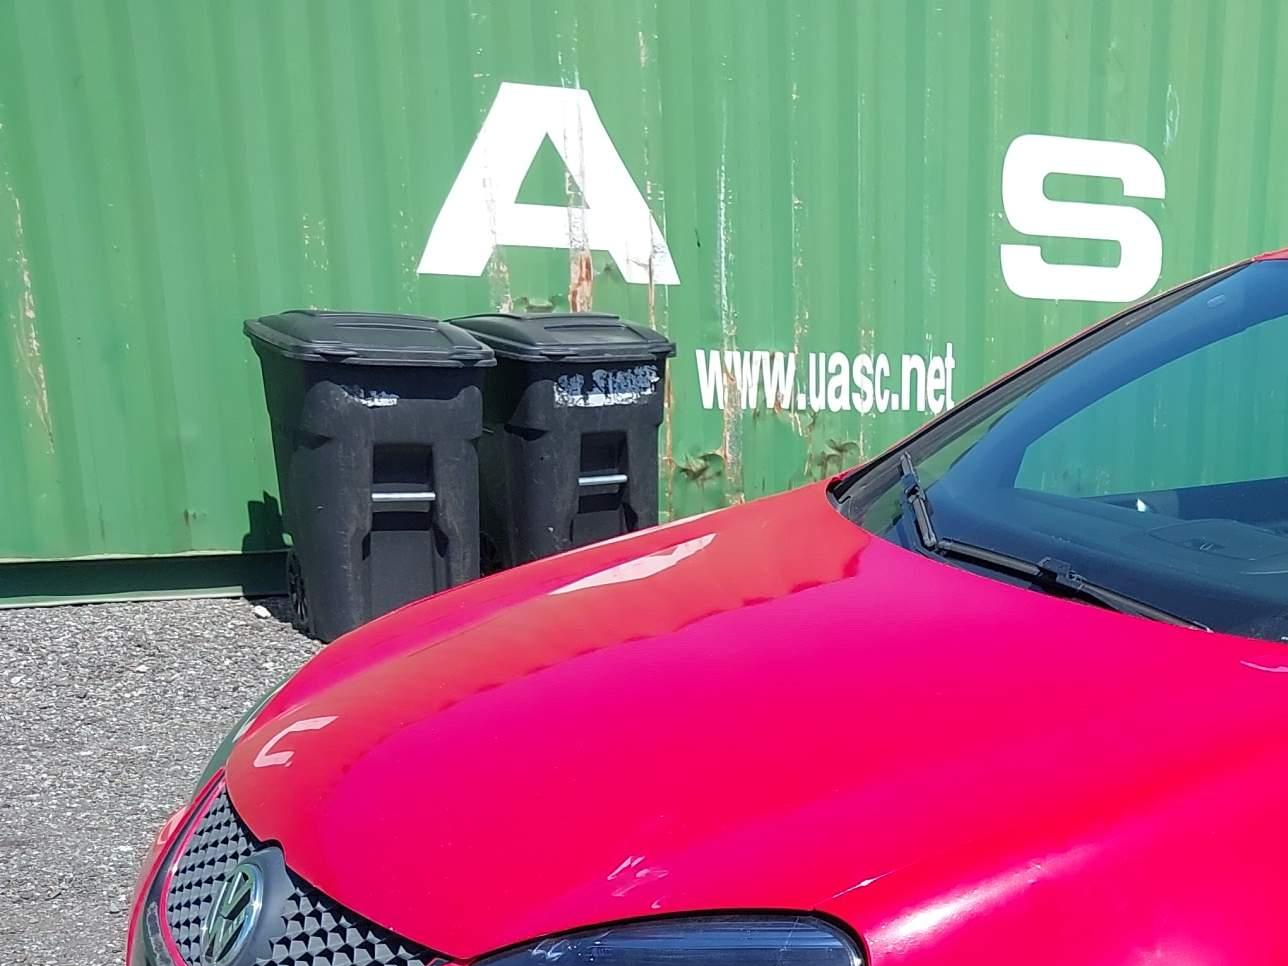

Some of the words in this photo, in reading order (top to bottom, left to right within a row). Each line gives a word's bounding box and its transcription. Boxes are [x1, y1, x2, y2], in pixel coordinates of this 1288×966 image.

[417, 81, 681, 286] A
[1000, 133, 1167, 303] S
[695, 342, 956, 413] www.uasc.net
